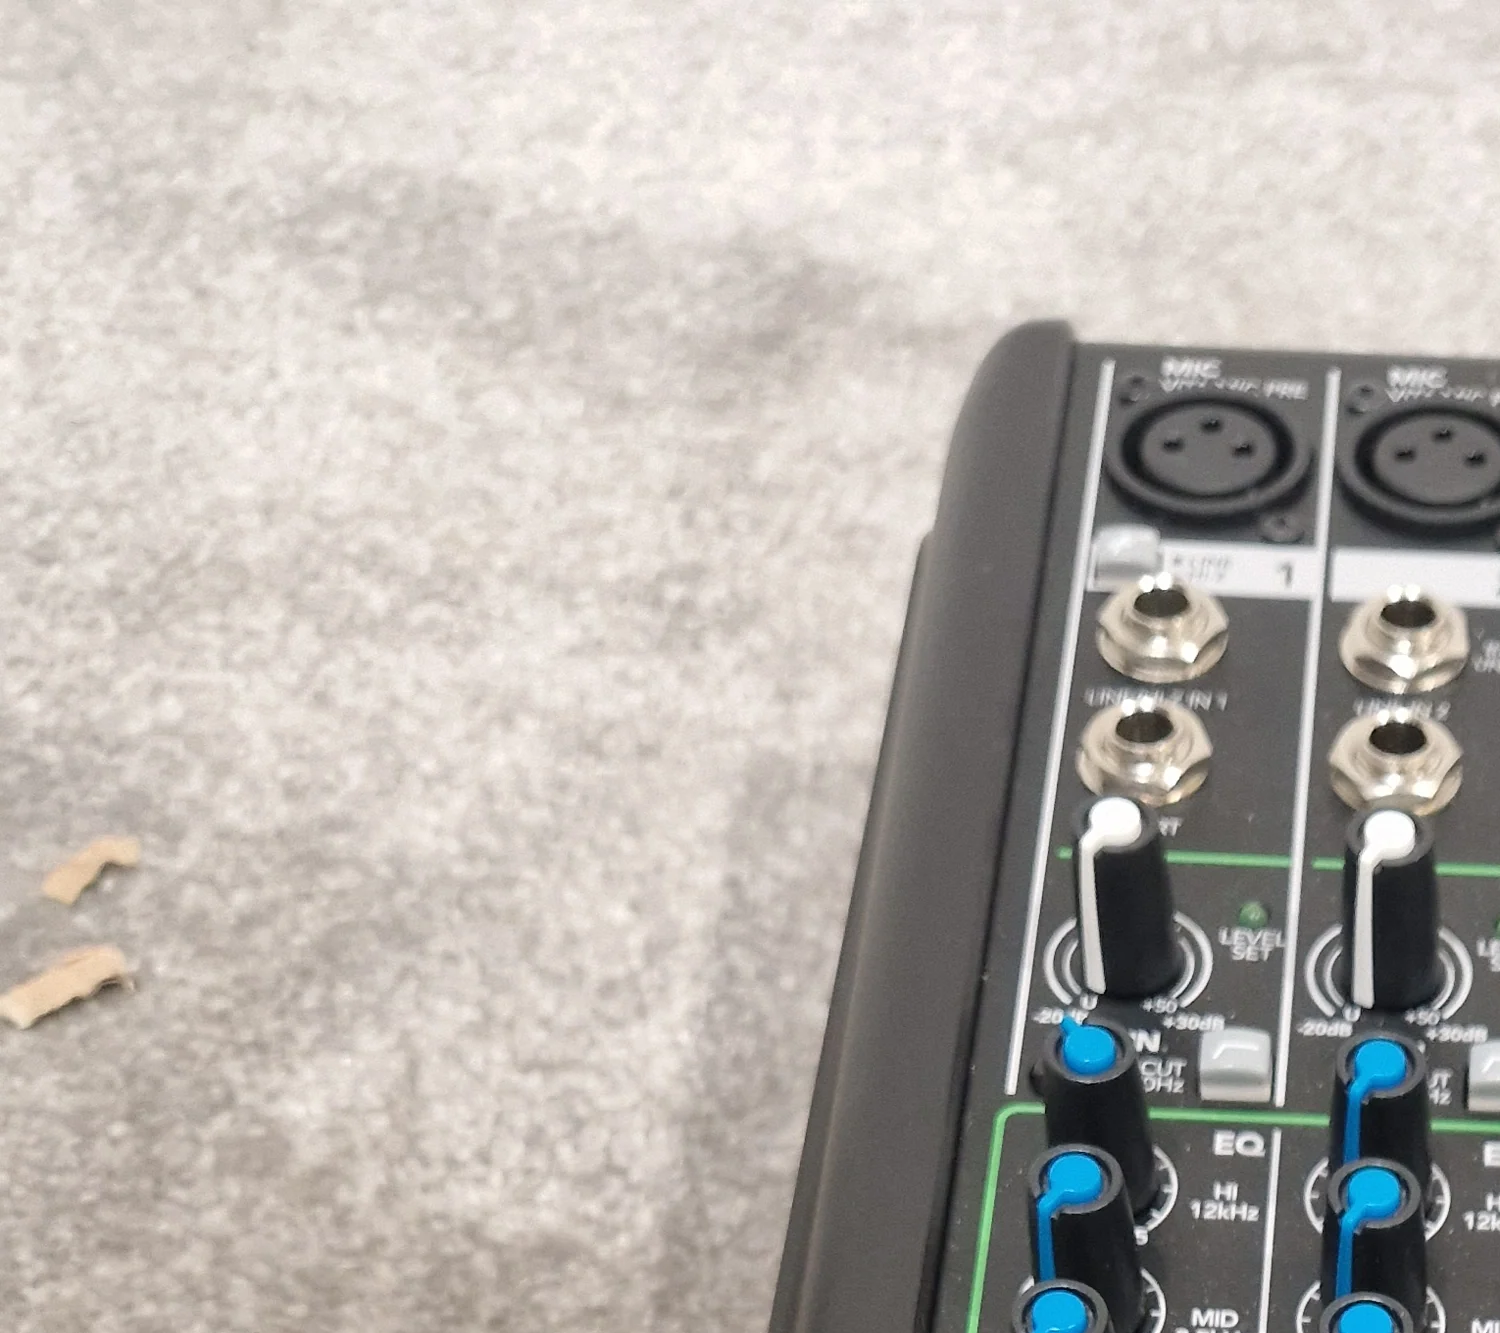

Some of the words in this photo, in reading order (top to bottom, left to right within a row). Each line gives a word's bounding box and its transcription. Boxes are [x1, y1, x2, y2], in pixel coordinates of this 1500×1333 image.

[1213, 1131, 1265, 1157] EQ
[1214, 1182, 1238, 1201] HI
[1191, 1201, 1260, 1222] 12kHz
[1191, 1308, 1238, 1330] MID
